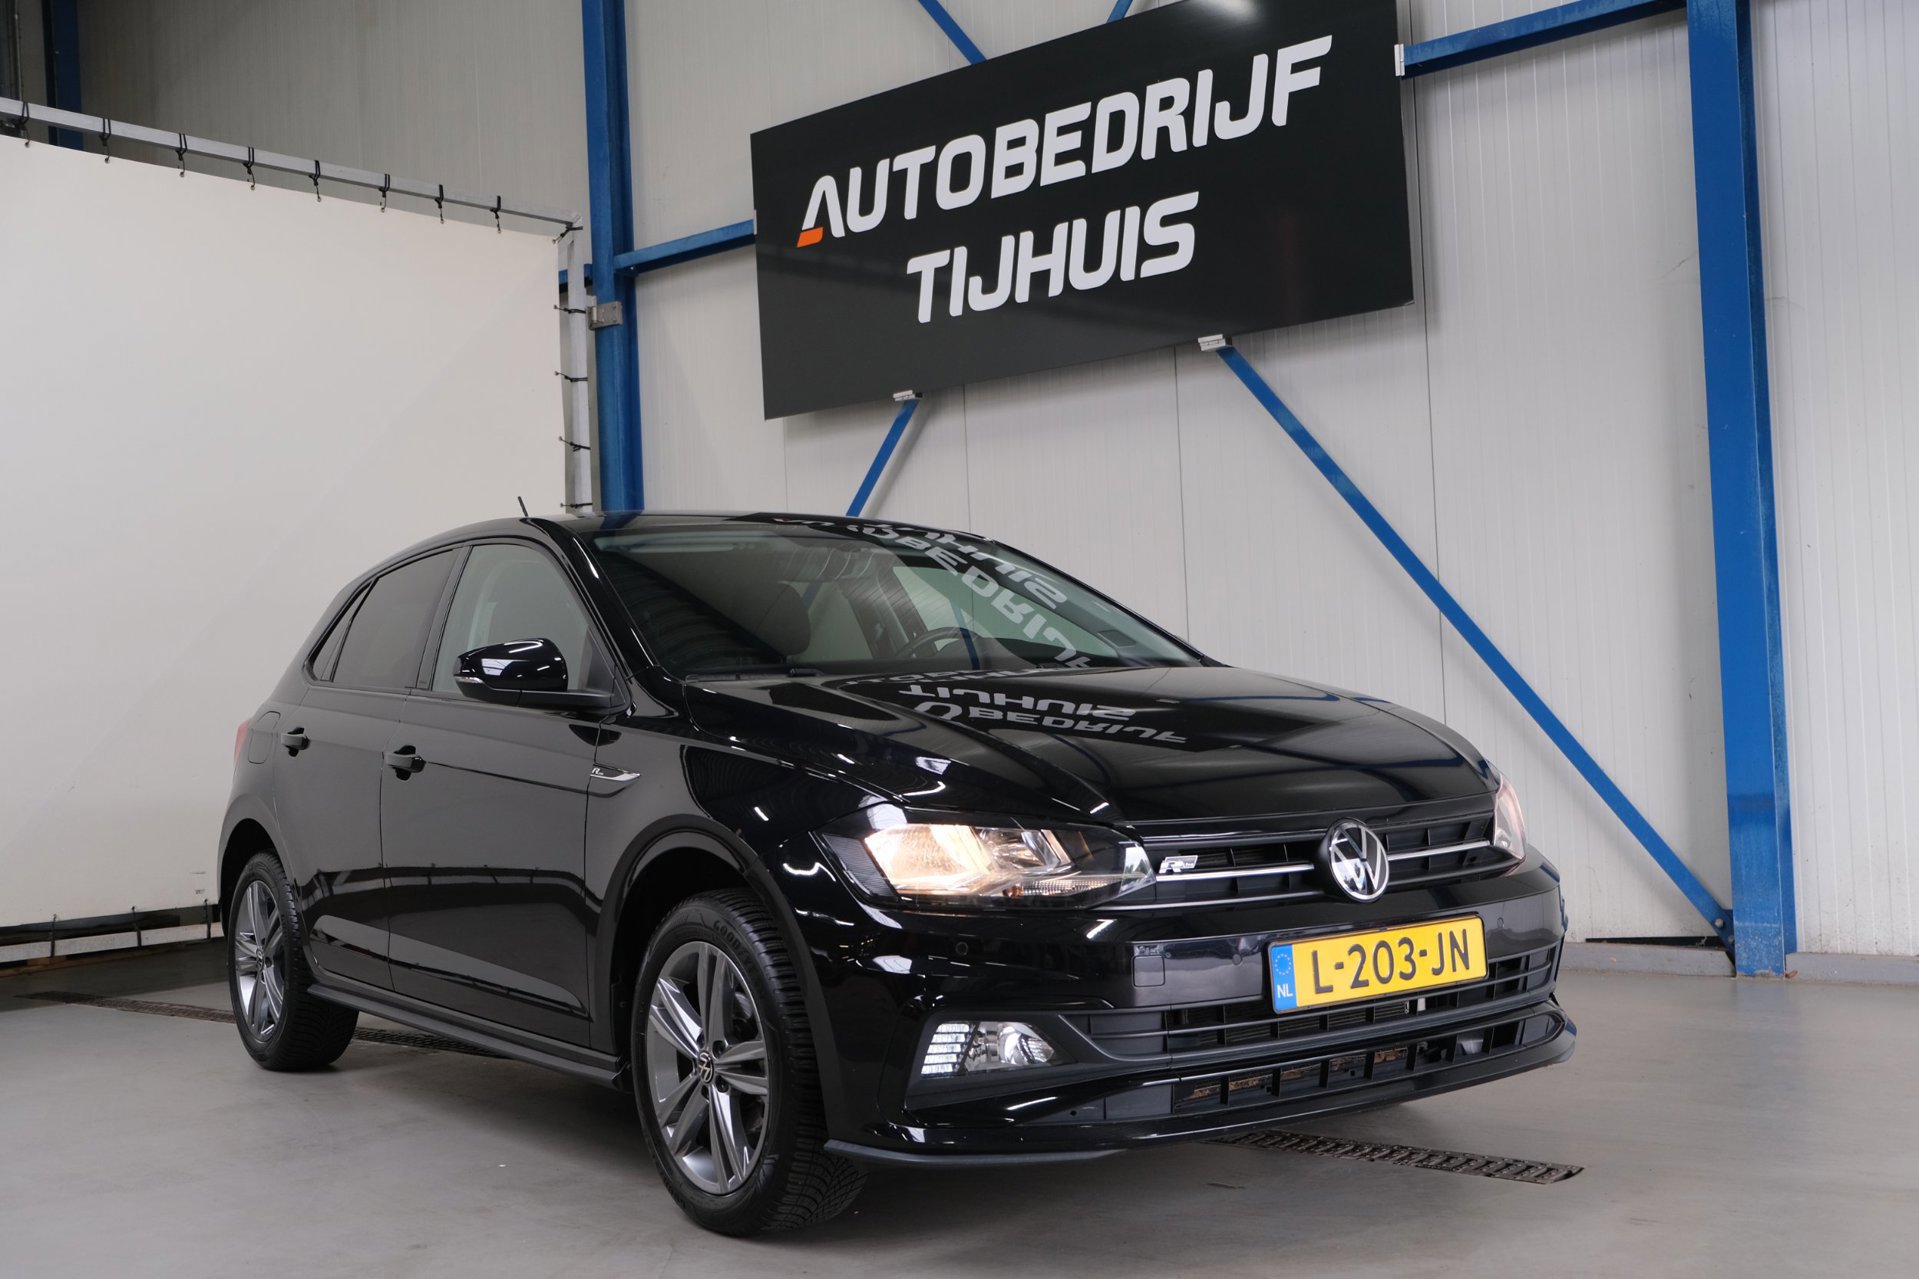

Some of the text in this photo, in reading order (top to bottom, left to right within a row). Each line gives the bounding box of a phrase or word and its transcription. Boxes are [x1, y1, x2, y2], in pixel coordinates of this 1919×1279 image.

[797, 35, 1332, 247] AUTOBEDRIJF
[906, 191, 1199, 323] TIJHUIS
[1277, 983, 1294, 998] NL
[1312, 928, 1470, 995] L-203-JN
